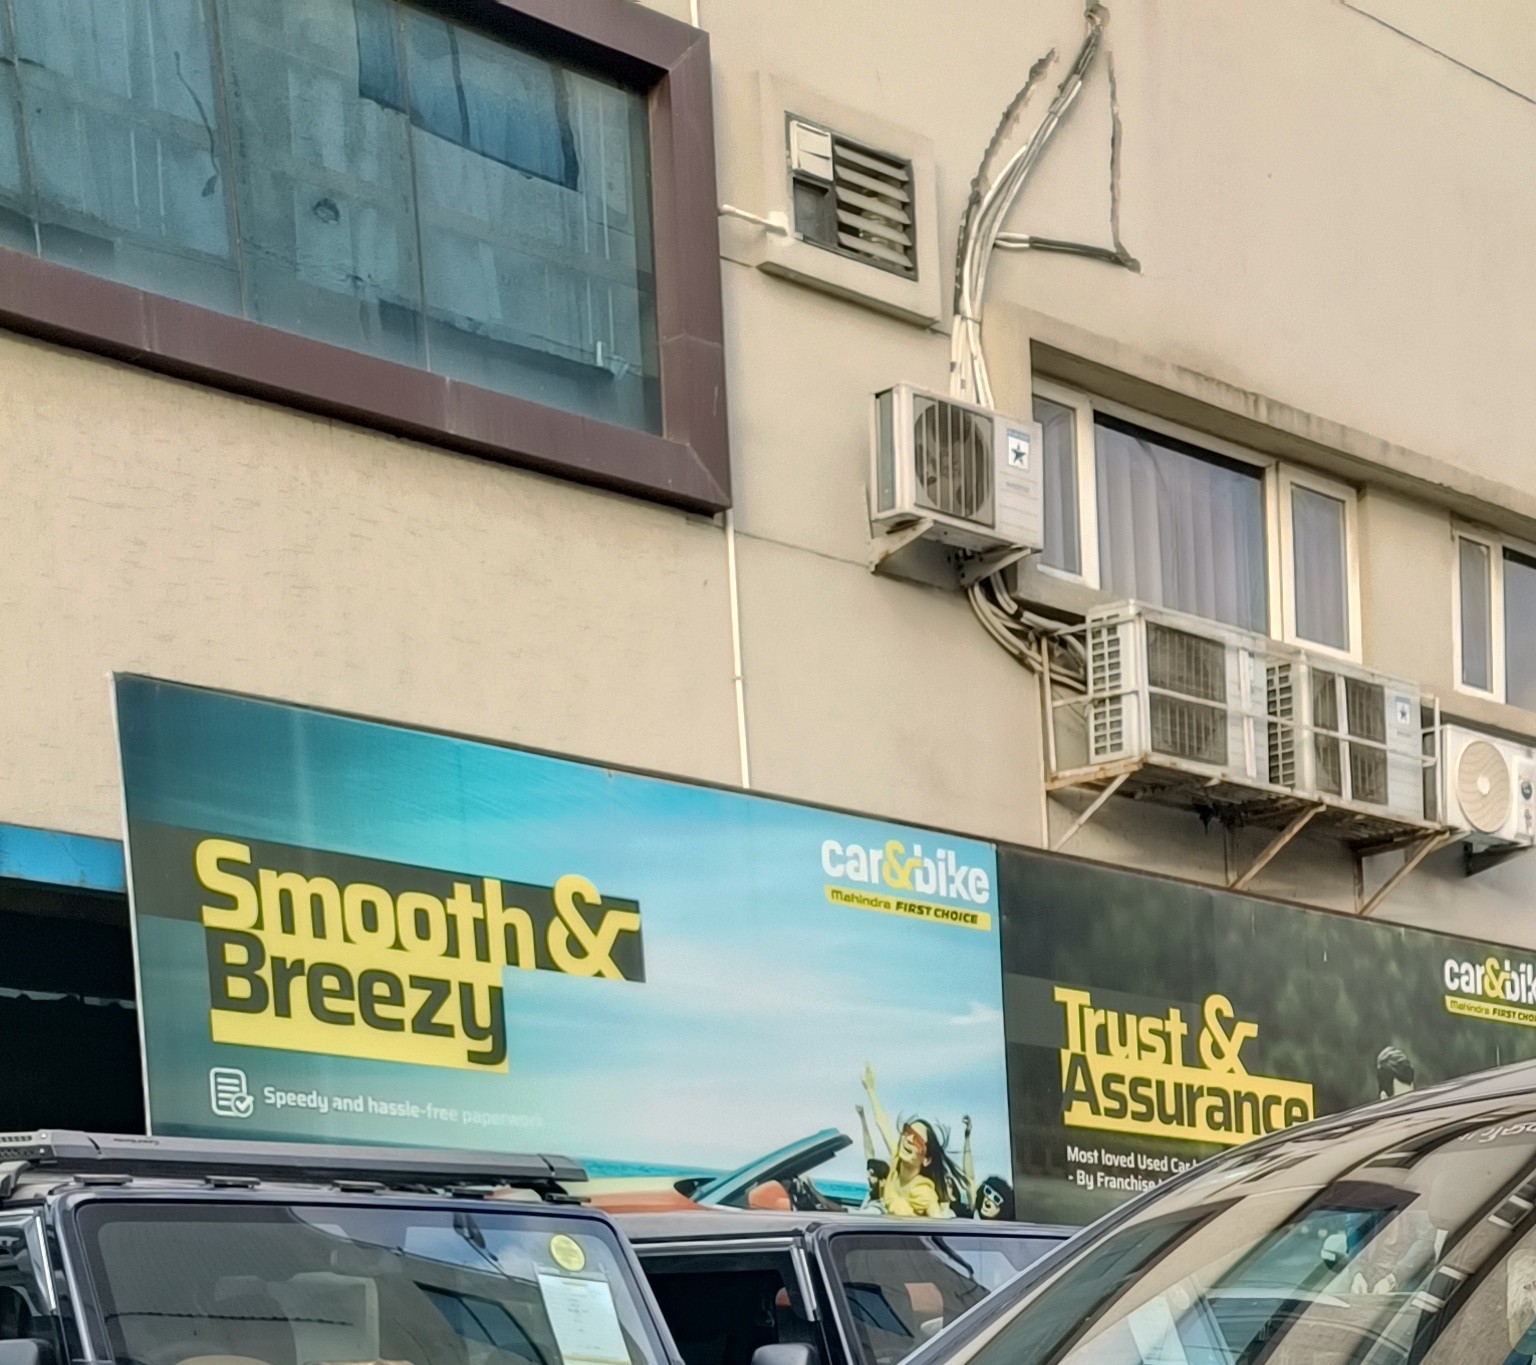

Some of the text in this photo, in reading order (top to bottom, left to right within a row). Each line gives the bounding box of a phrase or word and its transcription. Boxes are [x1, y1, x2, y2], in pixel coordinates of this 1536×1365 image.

[821, 840, 990, 904] car&bike
[195, 839, 640, 980] Smooth &
[895, 901, 932, 916] FIRST
[934, 908, 979, 924] CHOICE
[204, 926, 507, 1065] Breezy
[1492, 1007, 1516, 1020] FIRST
[1054, 986, 1259, 1075] Trust &
[263, 1087, 328, 1114] Speedy
[332, 1095, 364, 1113] and
[367, 1097, 459, 1122] hassle-free
[1062, 1052, 1310, 1135] Assurance
[1066, 1145, 1099, 1165] Most
[1101, 1149, 1135, 1168] loved
[1137, 1154, 1168, 1172] Used
[1076, 1170, 1094, 1190] By
[1096, 1172, 1156, 1192] Franchise
